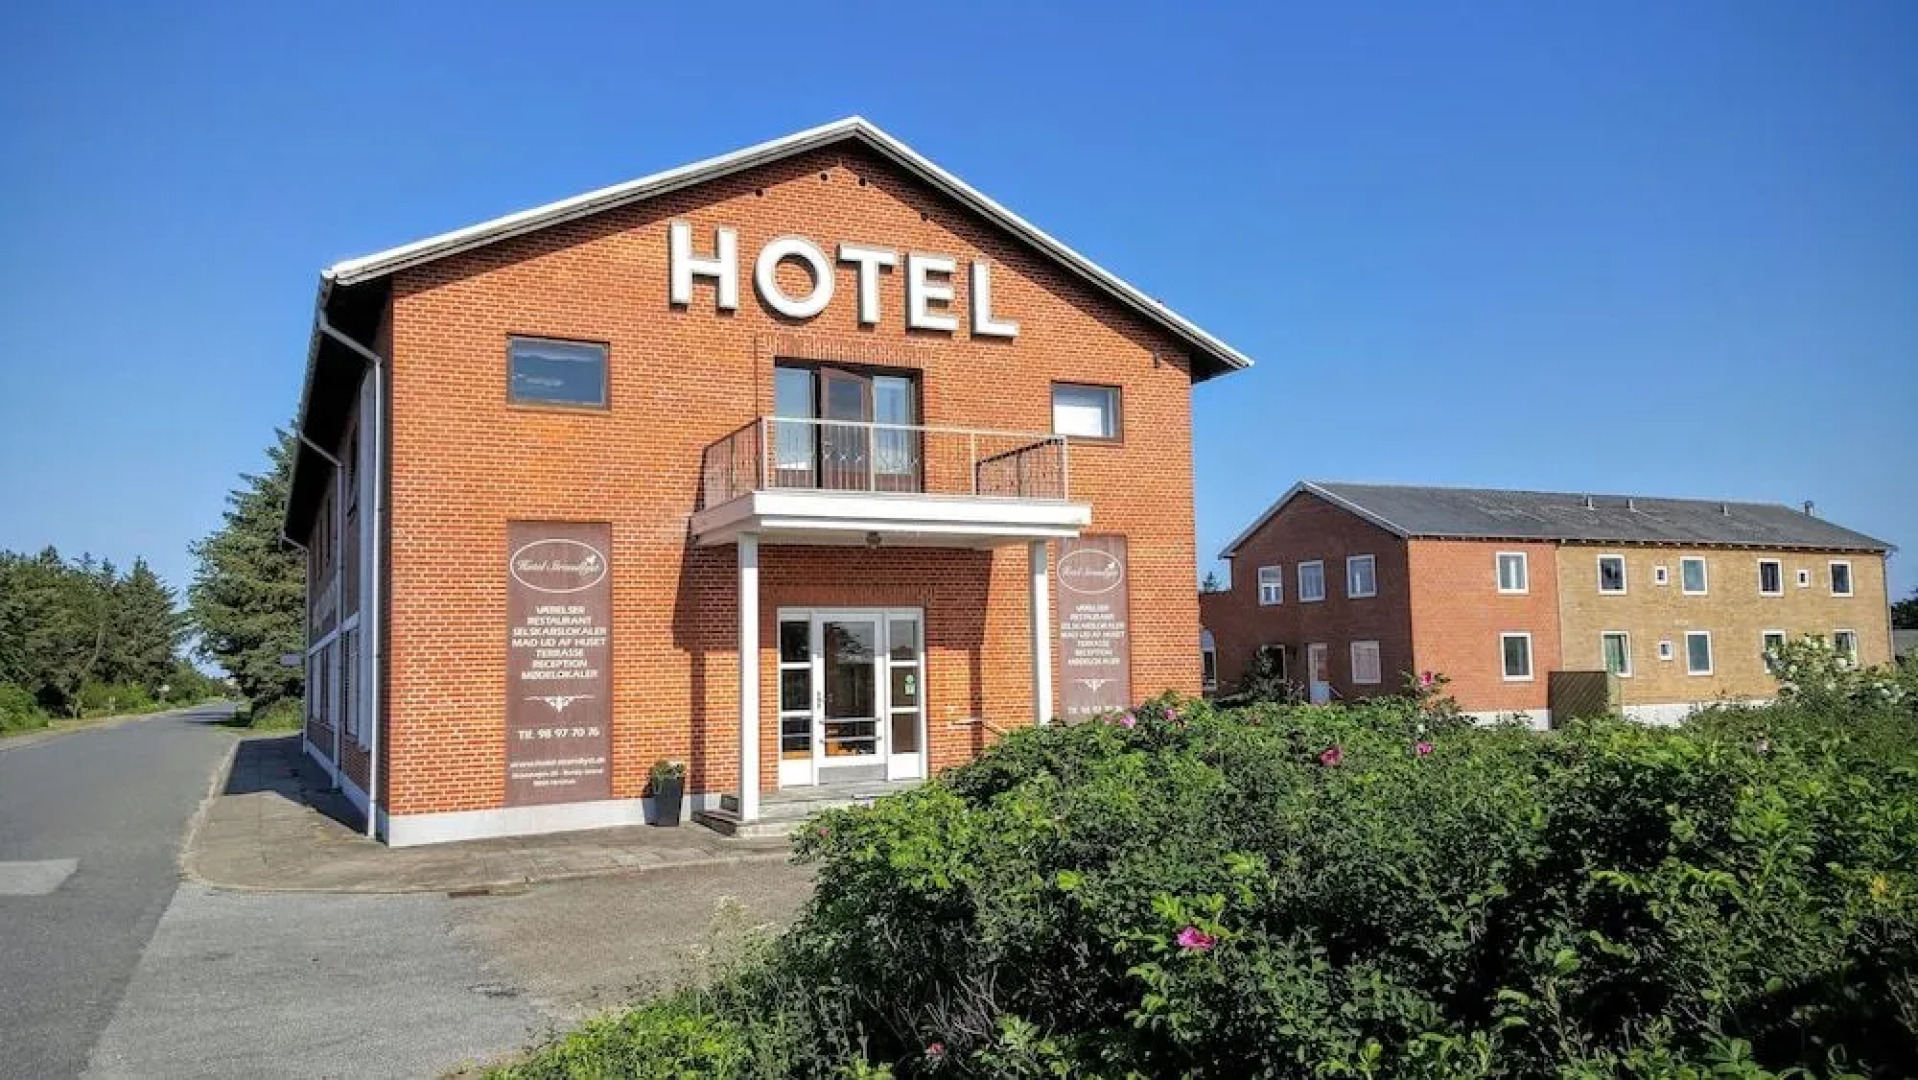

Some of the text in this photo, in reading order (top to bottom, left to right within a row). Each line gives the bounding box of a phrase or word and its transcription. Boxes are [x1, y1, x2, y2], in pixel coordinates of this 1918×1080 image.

[669, 220, 1020, 338] HOTEL
[526, 616, 592, 626] RESTAURANT
[511, 638, 538, 648] MAD
[540, 638, 556, 647] UD
[574, 637, 606, 647] HUSET
[532, 659, 588, 669] RECEPTION
